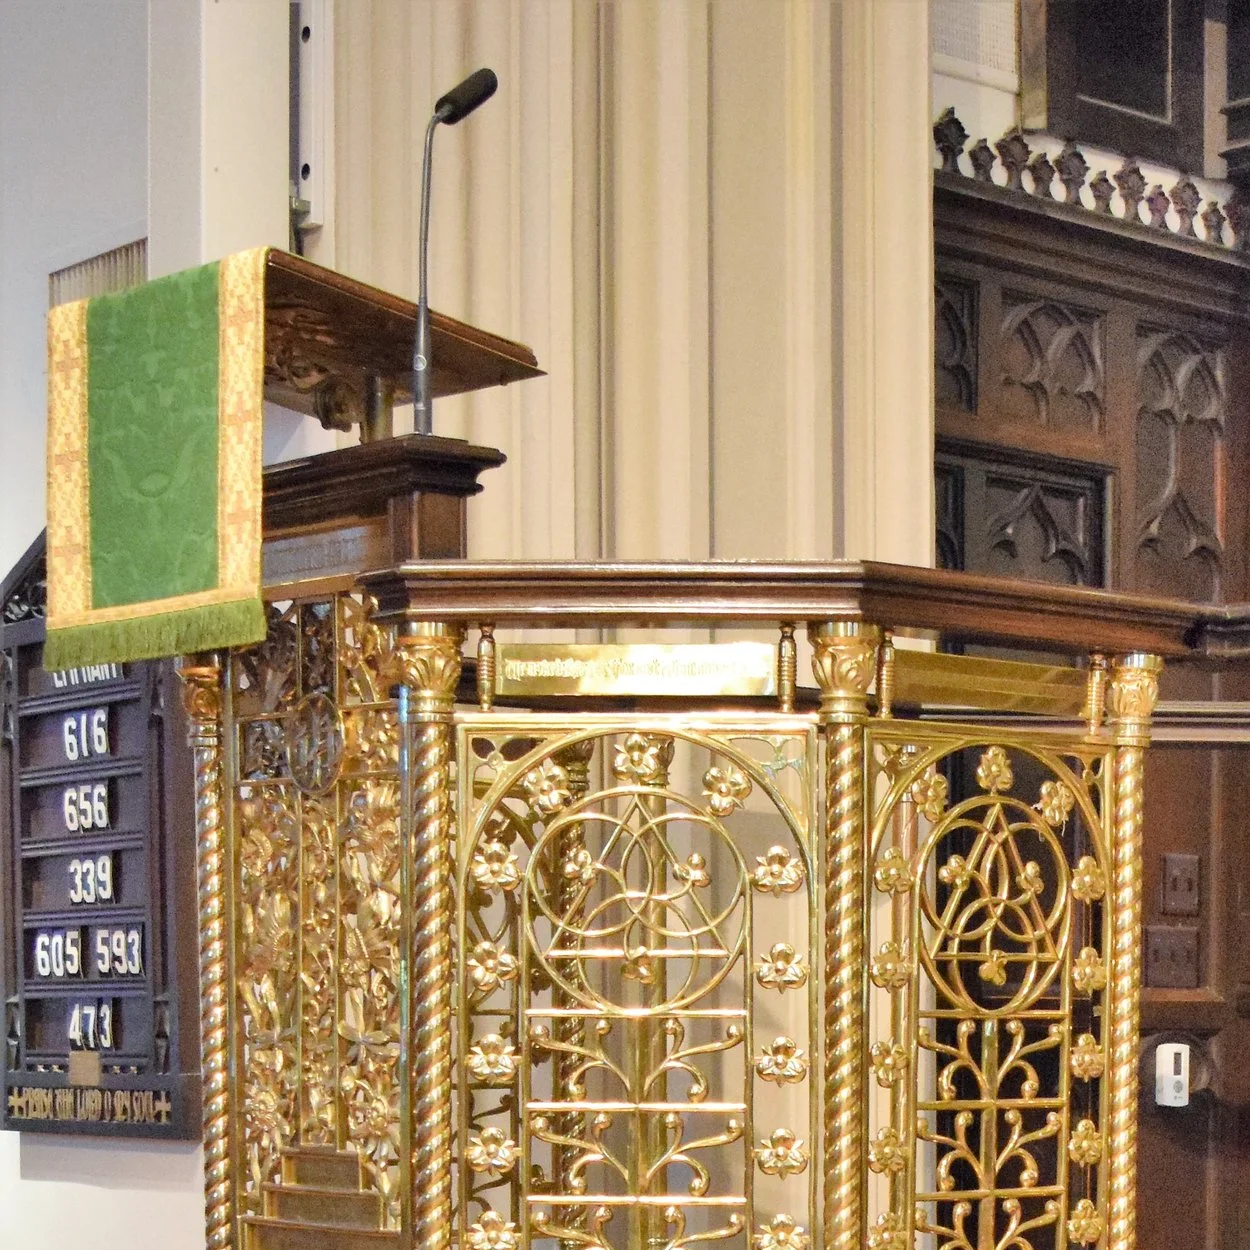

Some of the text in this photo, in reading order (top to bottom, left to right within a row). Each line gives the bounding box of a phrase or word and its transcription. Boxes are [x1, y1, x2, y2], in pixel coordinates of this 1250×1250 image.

[63, 709, 107, 760] 616
[63, 784, 108, 831] 656
[69, 855, 112, 903] 339
[36, 929, 141, 977] 605 593
[69, 1004, 111, 1048] 473
